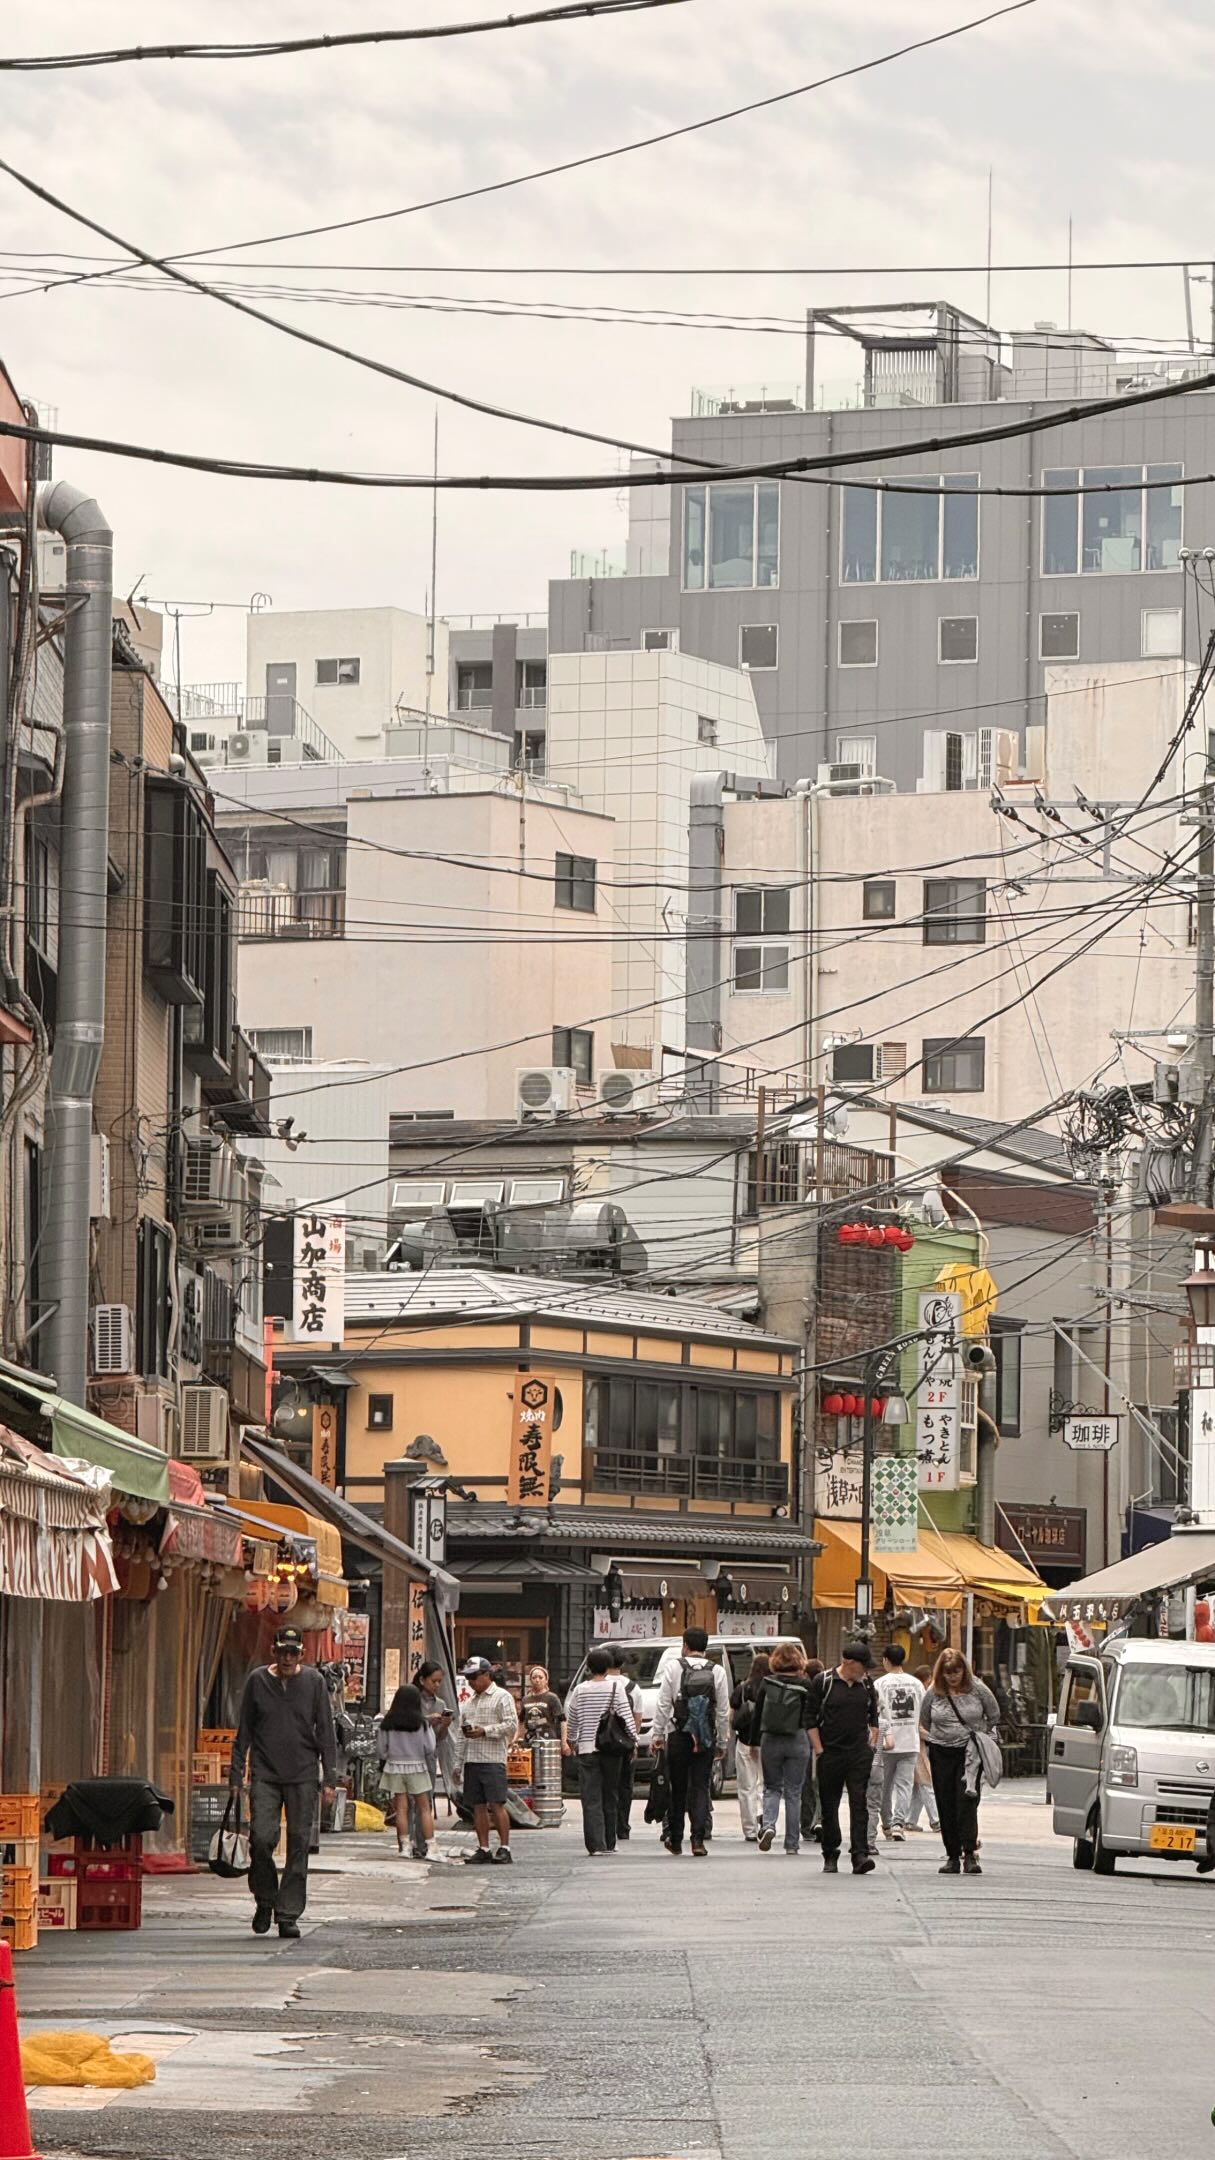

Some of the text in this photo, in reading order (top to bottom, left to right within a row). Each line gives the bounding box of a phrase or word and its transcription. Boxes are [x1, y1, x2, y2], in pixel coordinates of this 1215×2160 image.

[300, 1213, 327, 1333] 山加商店
[875, 1337, 919, 1380] GREEN ROAD
[520, 1408, 546, 1423] 焼肉
[1071, 1423, 1111, 1444] 珈琲
[518, 1423, 546, 1500] 寿限無
[926, 1471, 946, 1483] 1F
